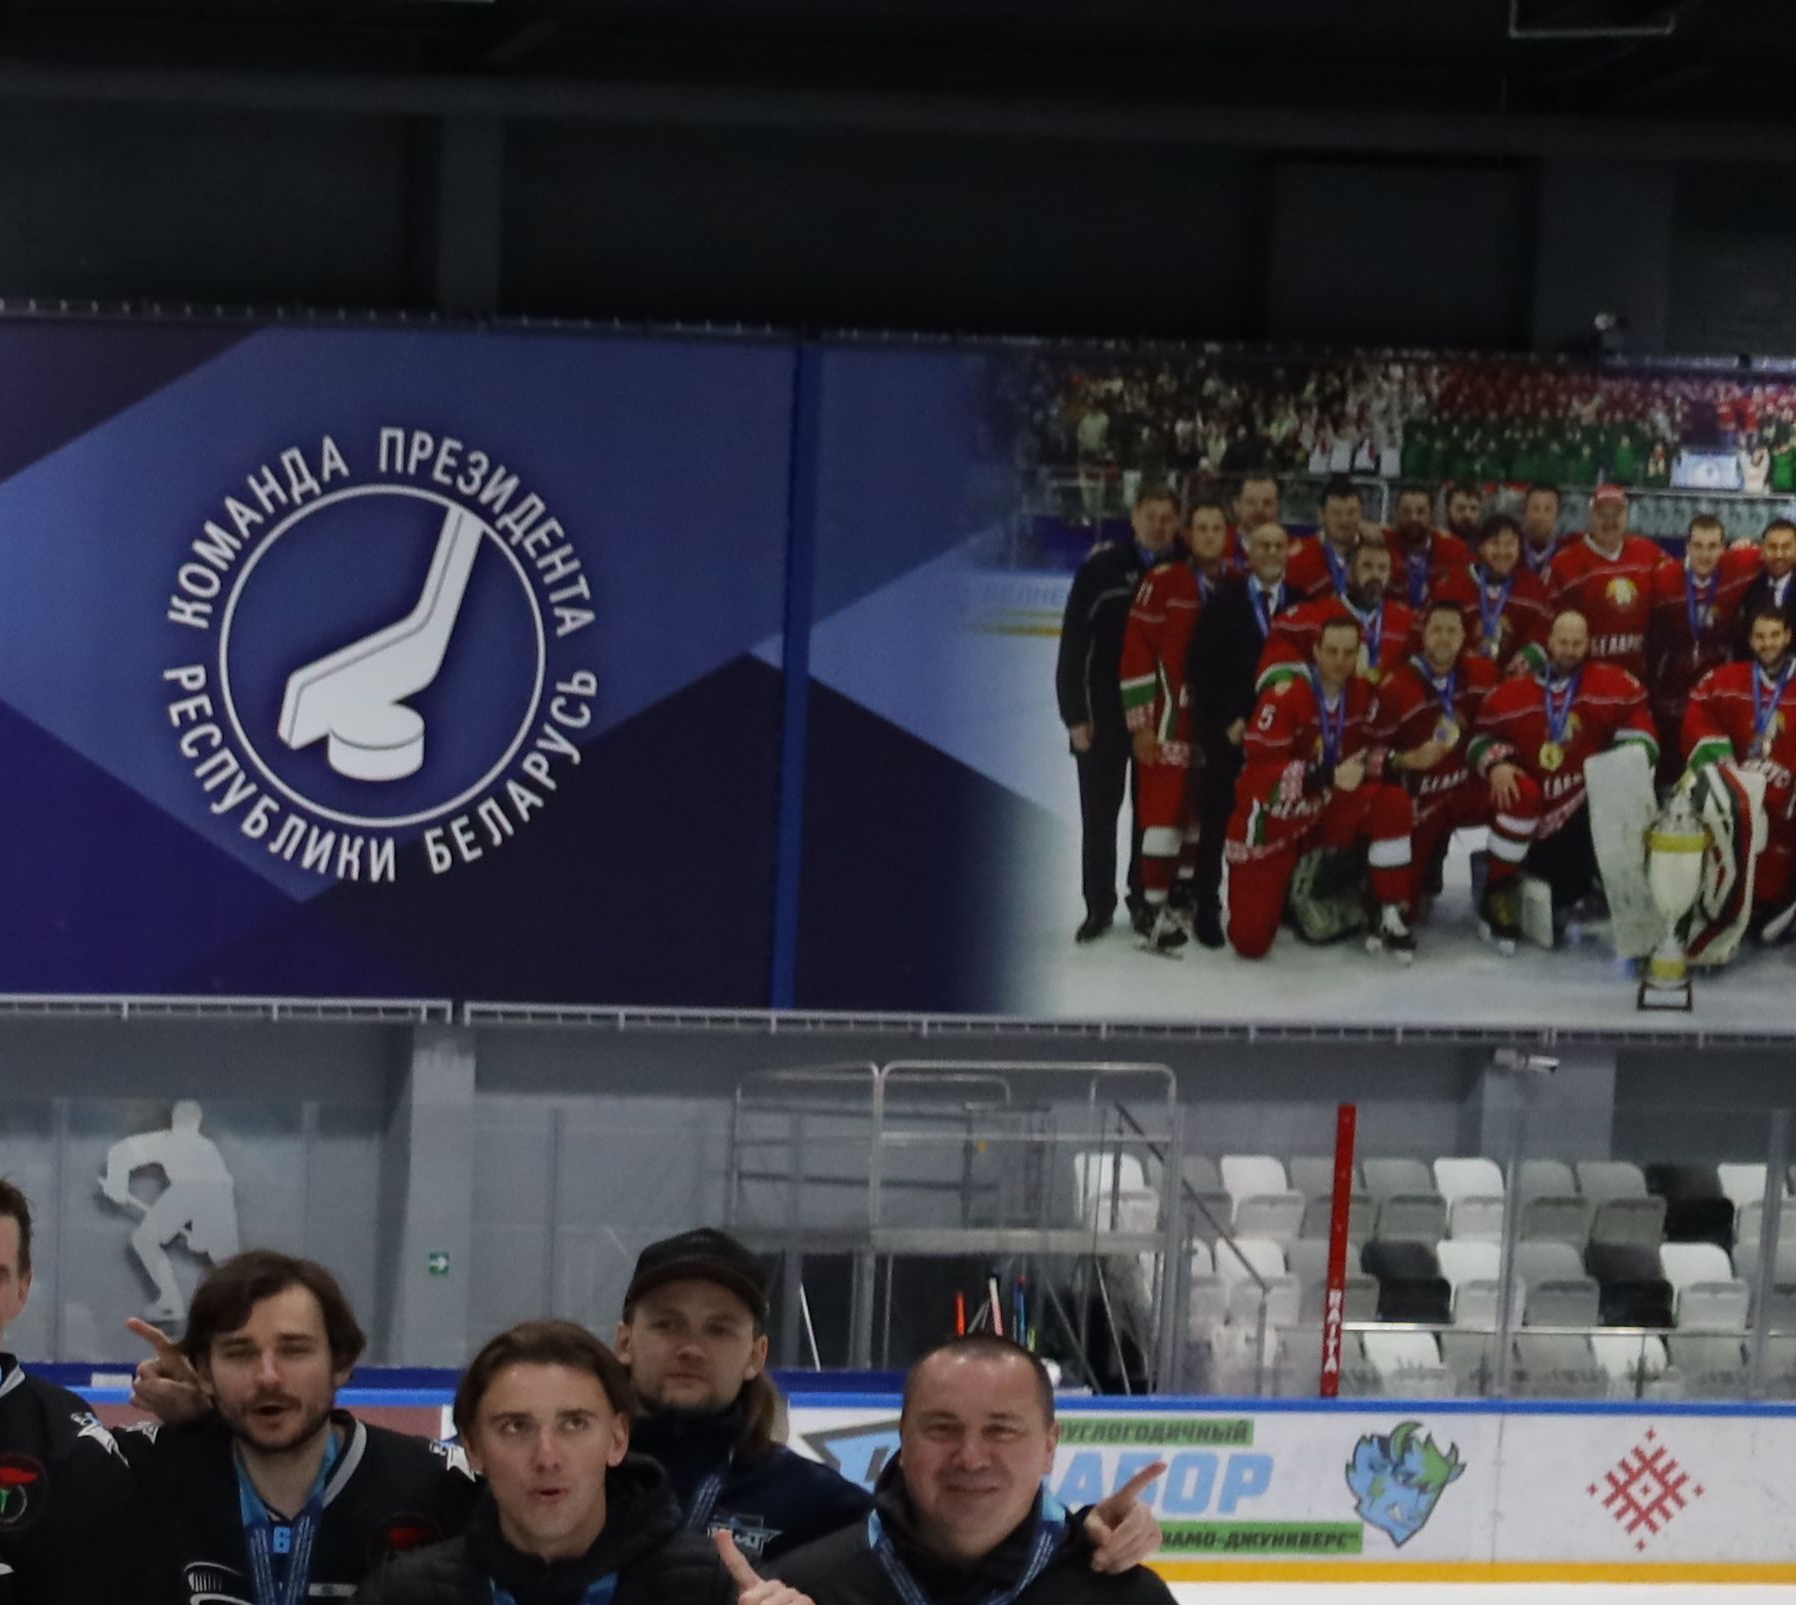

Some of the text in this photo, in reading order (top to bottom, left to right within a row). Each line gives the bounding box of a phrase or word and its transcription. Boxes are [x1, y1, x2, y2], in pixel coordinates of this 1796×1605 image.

[167, 426, 598, 637] КОМАНДА ПРЕЗИДЕНТА
[162, 663, 599, 883] РЕСПУБЛИКИ БЕЛАРУСЬ
[1059, 1420, 1250, 1444] УГЛОГОДИЧНЫЙ
[1055, 1452, 1275, 1515] АБОР
[1159, 1529, 1361, 1551] НАМО-ДЖУНИВЕРС"
